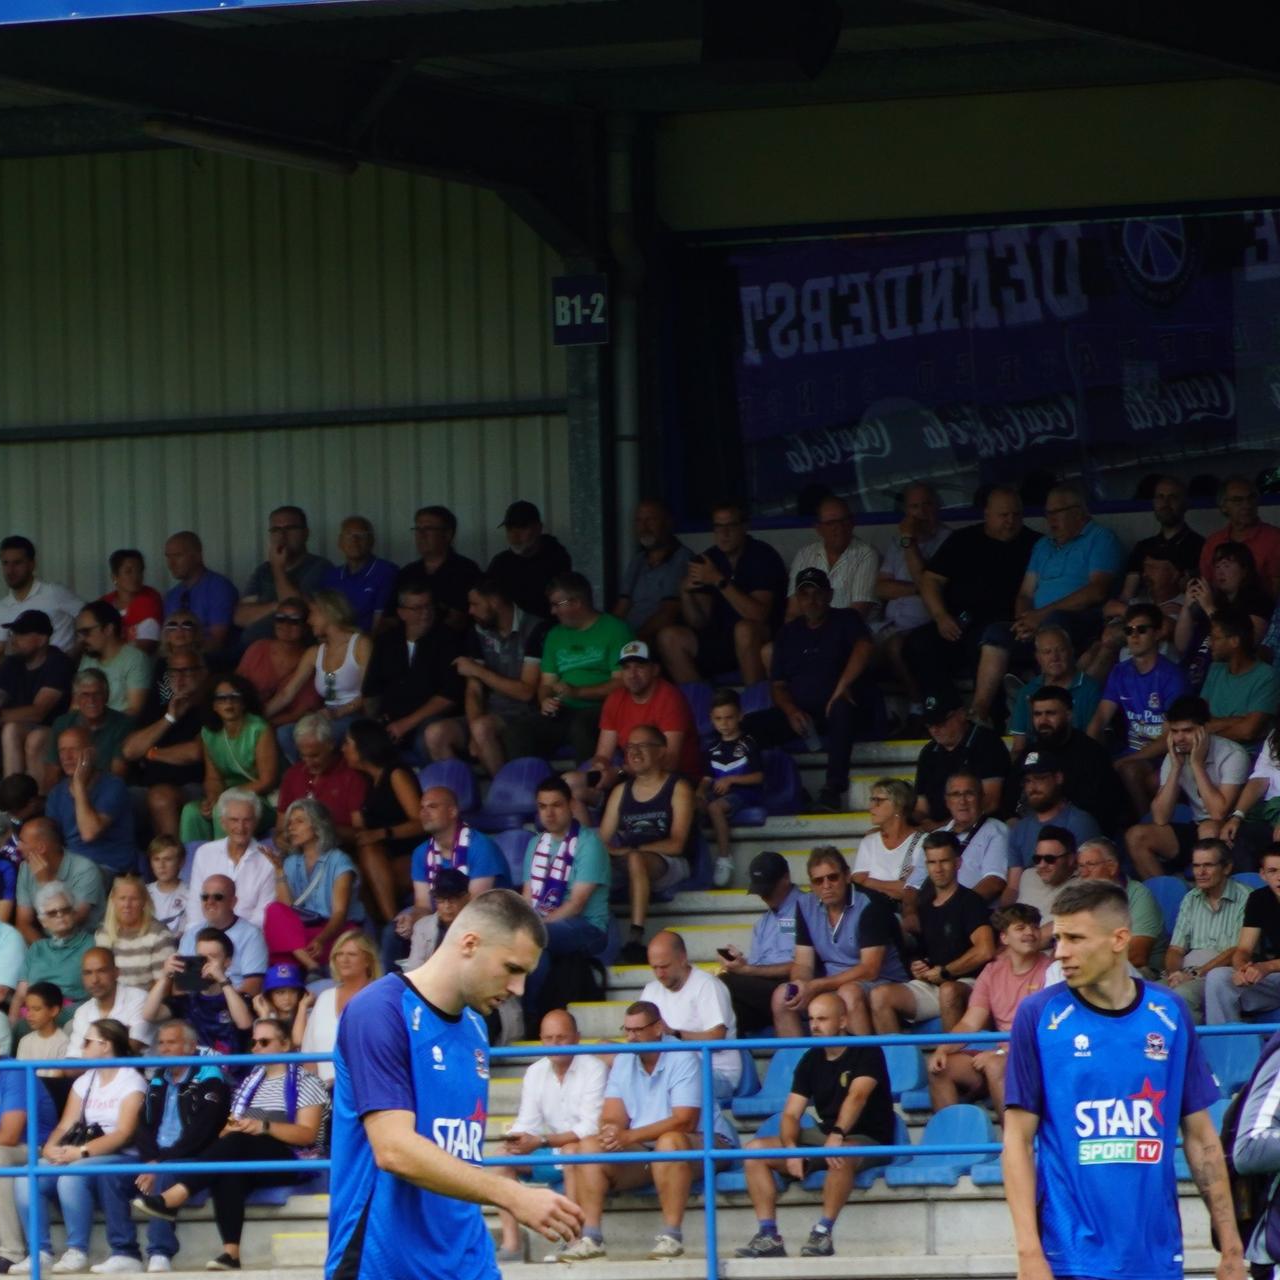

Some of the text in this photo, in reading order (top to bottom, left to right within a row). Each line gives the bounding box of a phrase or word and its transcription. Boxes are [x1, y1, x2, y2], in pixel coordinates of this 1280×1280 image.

[555, 292, 606, 326] B1-2
[1075, 1098, 1158, 1138] STAR
[432, 1117, 483, 1162] STAR
[1080, 1143, 1158, 1161] SPORT TV
